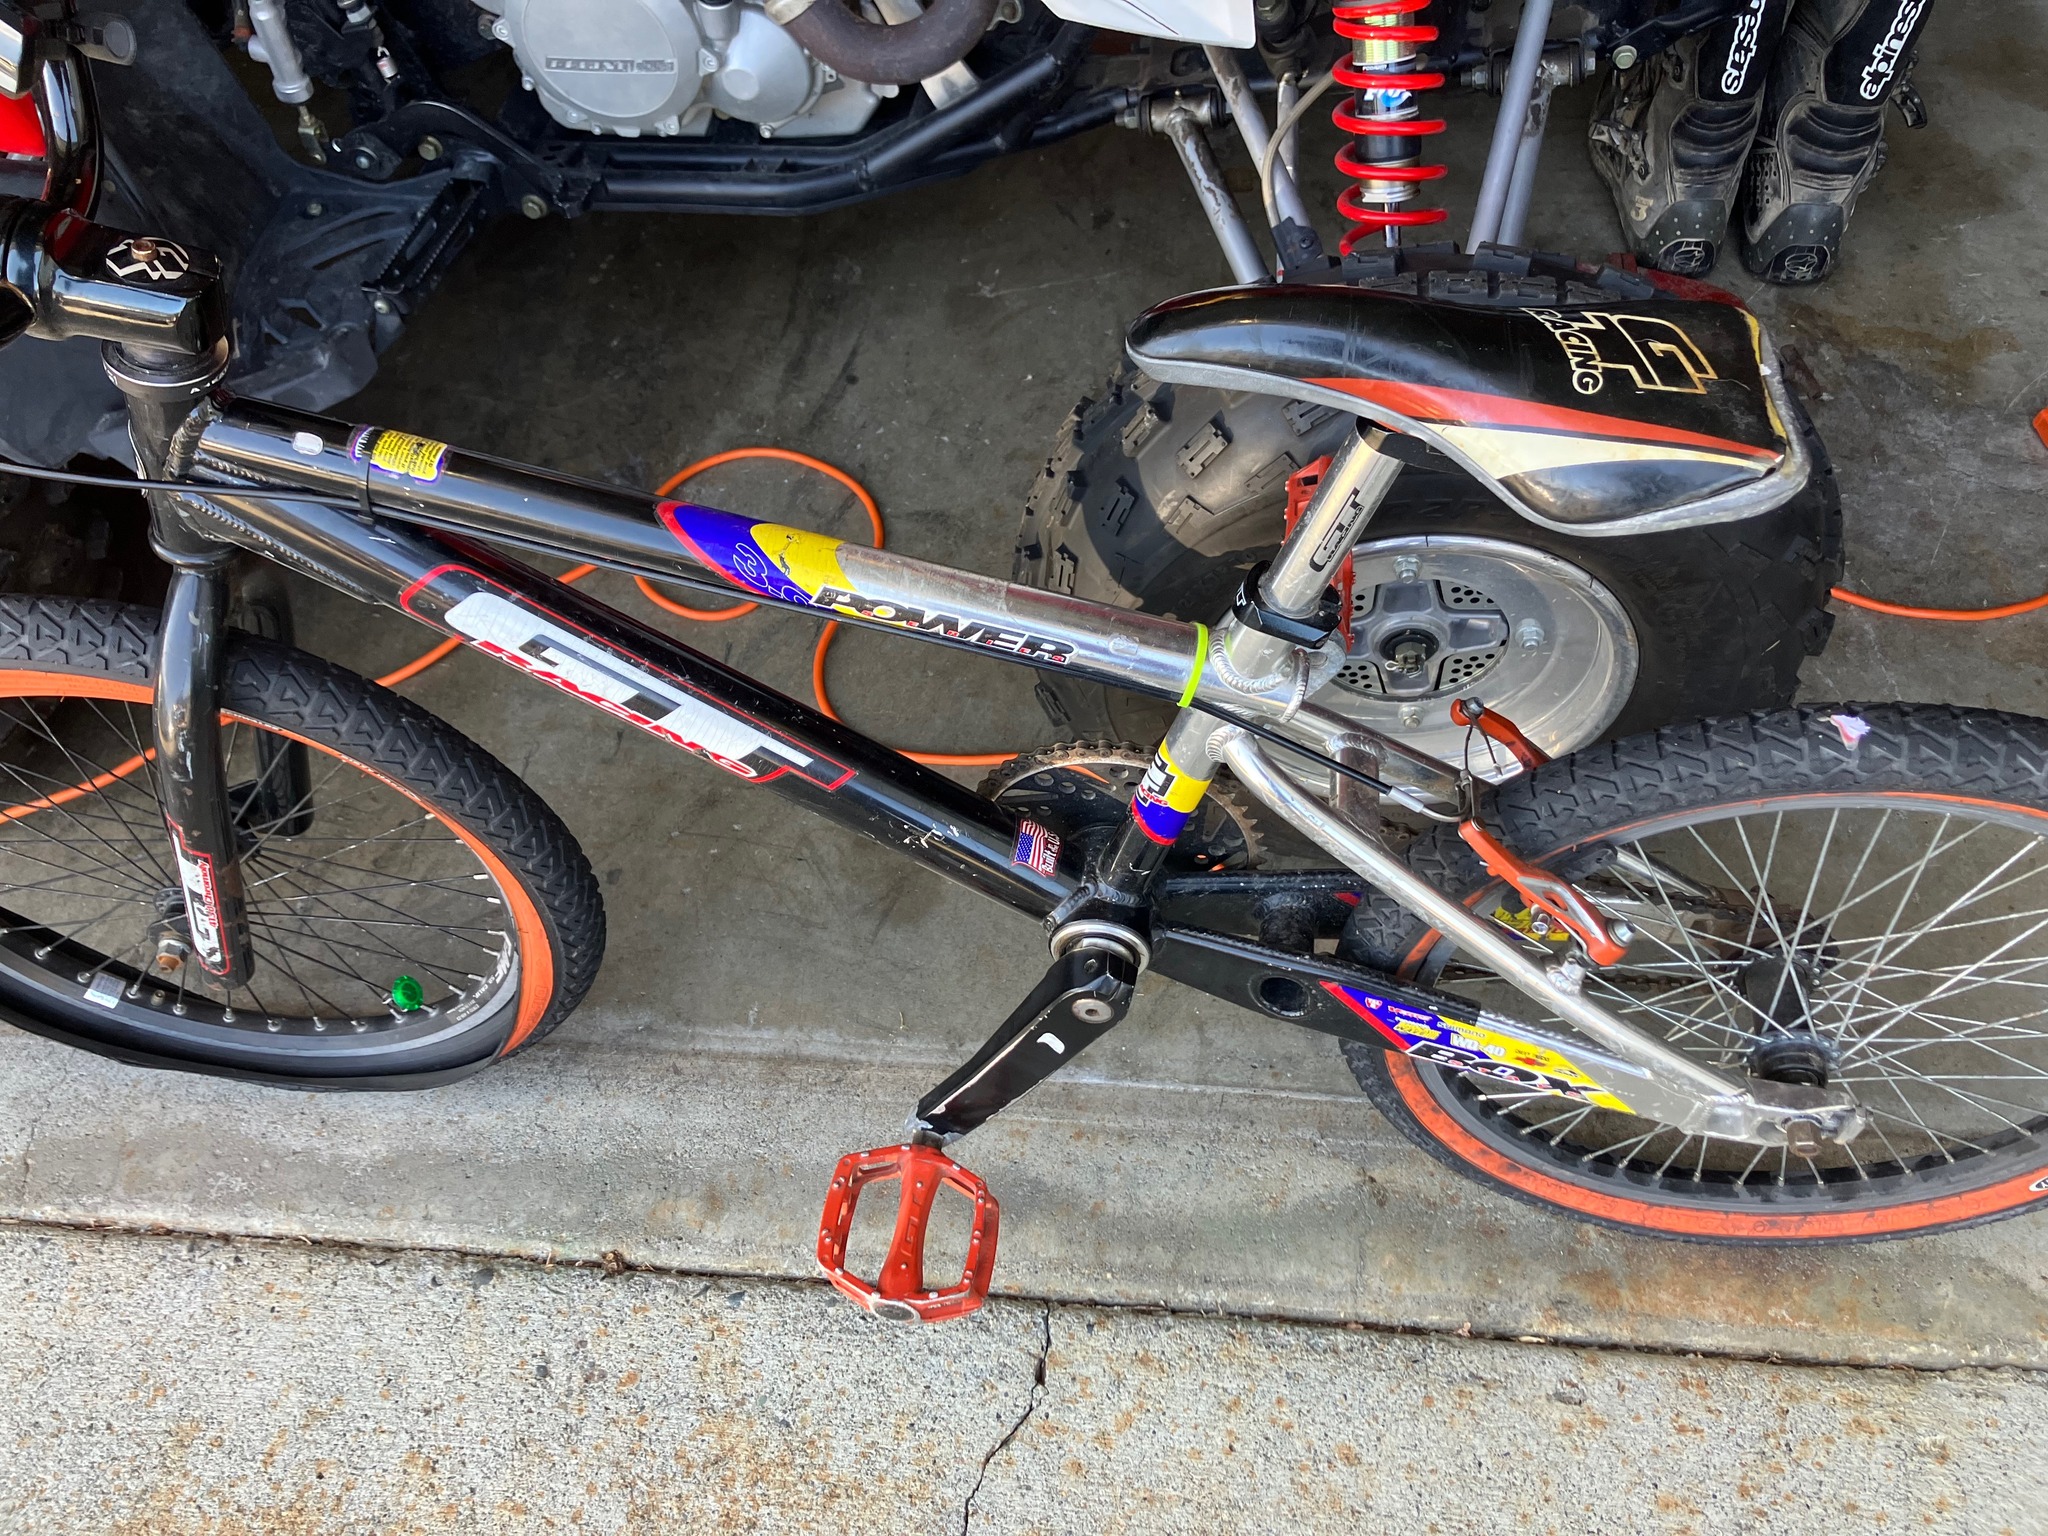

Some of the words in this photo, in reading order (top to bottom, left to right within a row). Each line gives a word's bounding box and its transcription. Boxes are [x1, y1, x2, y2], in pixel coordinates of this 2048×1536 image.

[1520, 307, 1603, 395] RACING
[811, 585, 1080, 665] POWER
[444, 591, 815, 767] GT
[472, 640, 759, 779] RACING
[1405, 1040, 1606, 1106] BOX
[1450, 1032, 1506, 1057] WD-40
